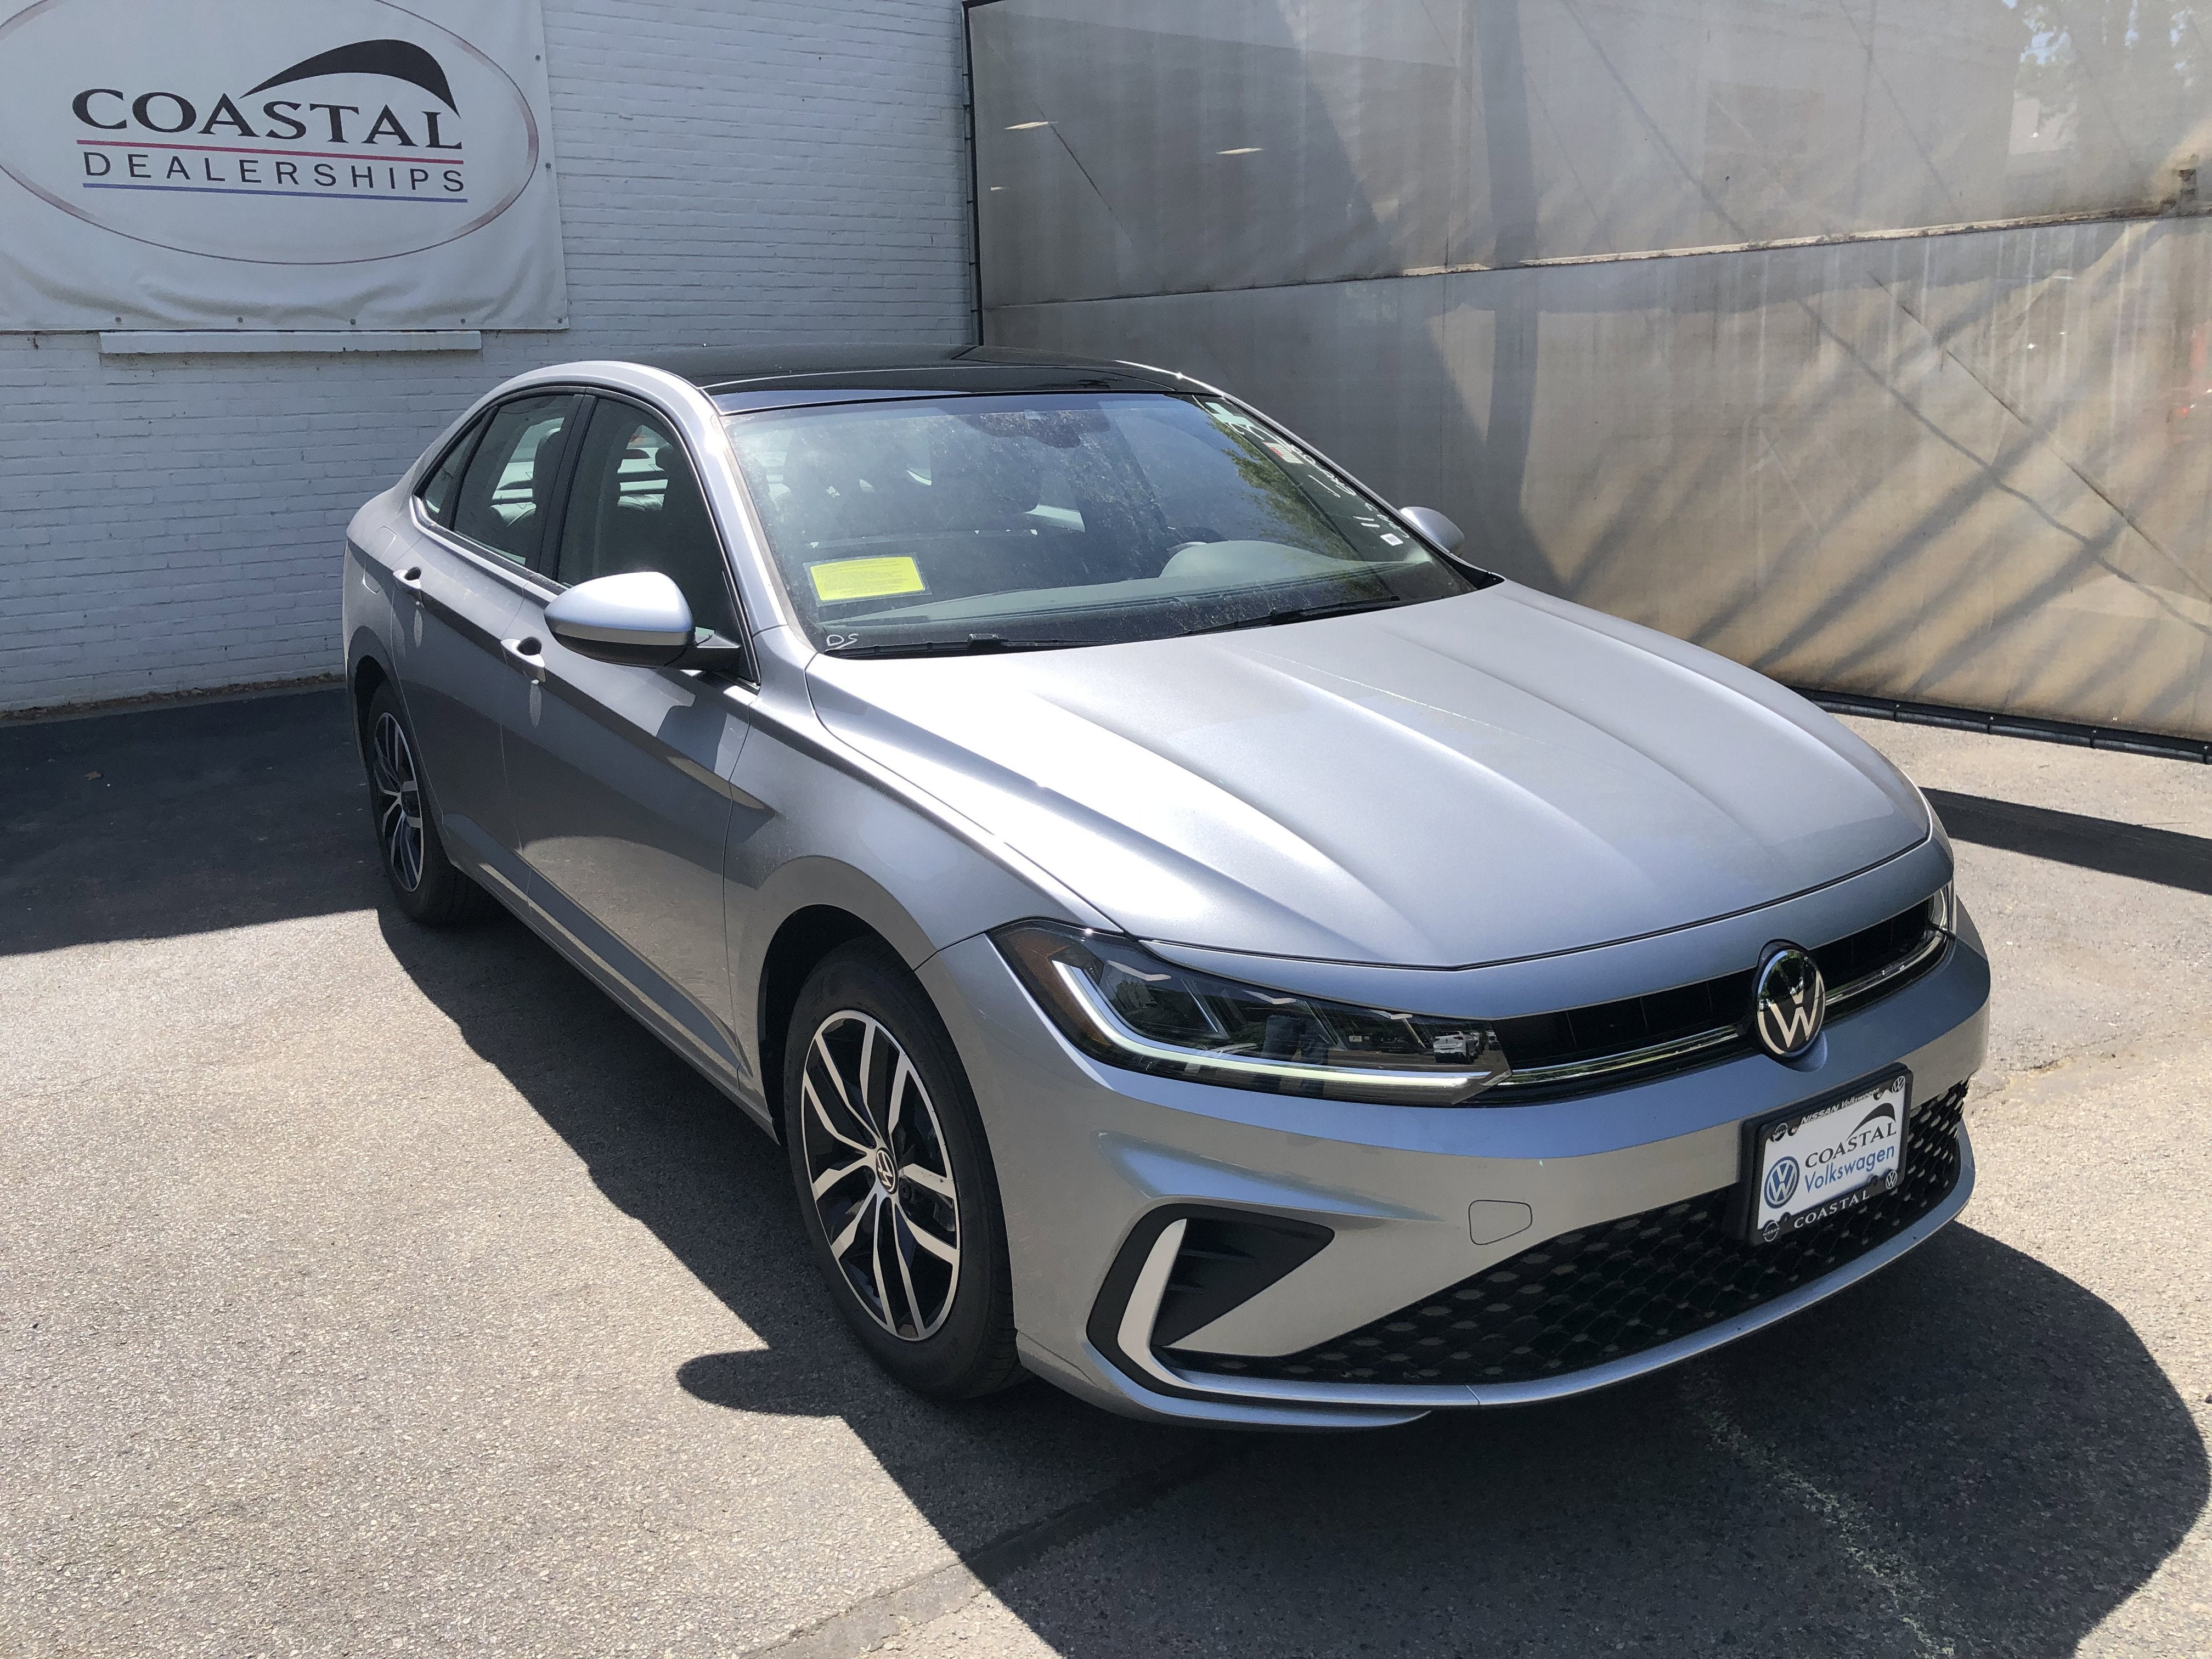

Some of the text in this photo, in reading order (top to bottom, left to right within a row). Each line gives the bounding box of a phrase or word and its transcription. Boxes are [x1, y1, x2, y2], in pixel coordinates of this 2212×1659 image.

[72, 88, 463, 150] COASTAL
[83, 151, 465, 193] DEALERSHIPS
[1801, 1104, 1839, 1125] NISSAN
[1805, 1122, 1897, 1168] COASTAL
[1804, 1146, 1894, 1193] Volkswagen
[1794, 1190, 1870, 1228] COASTAL
